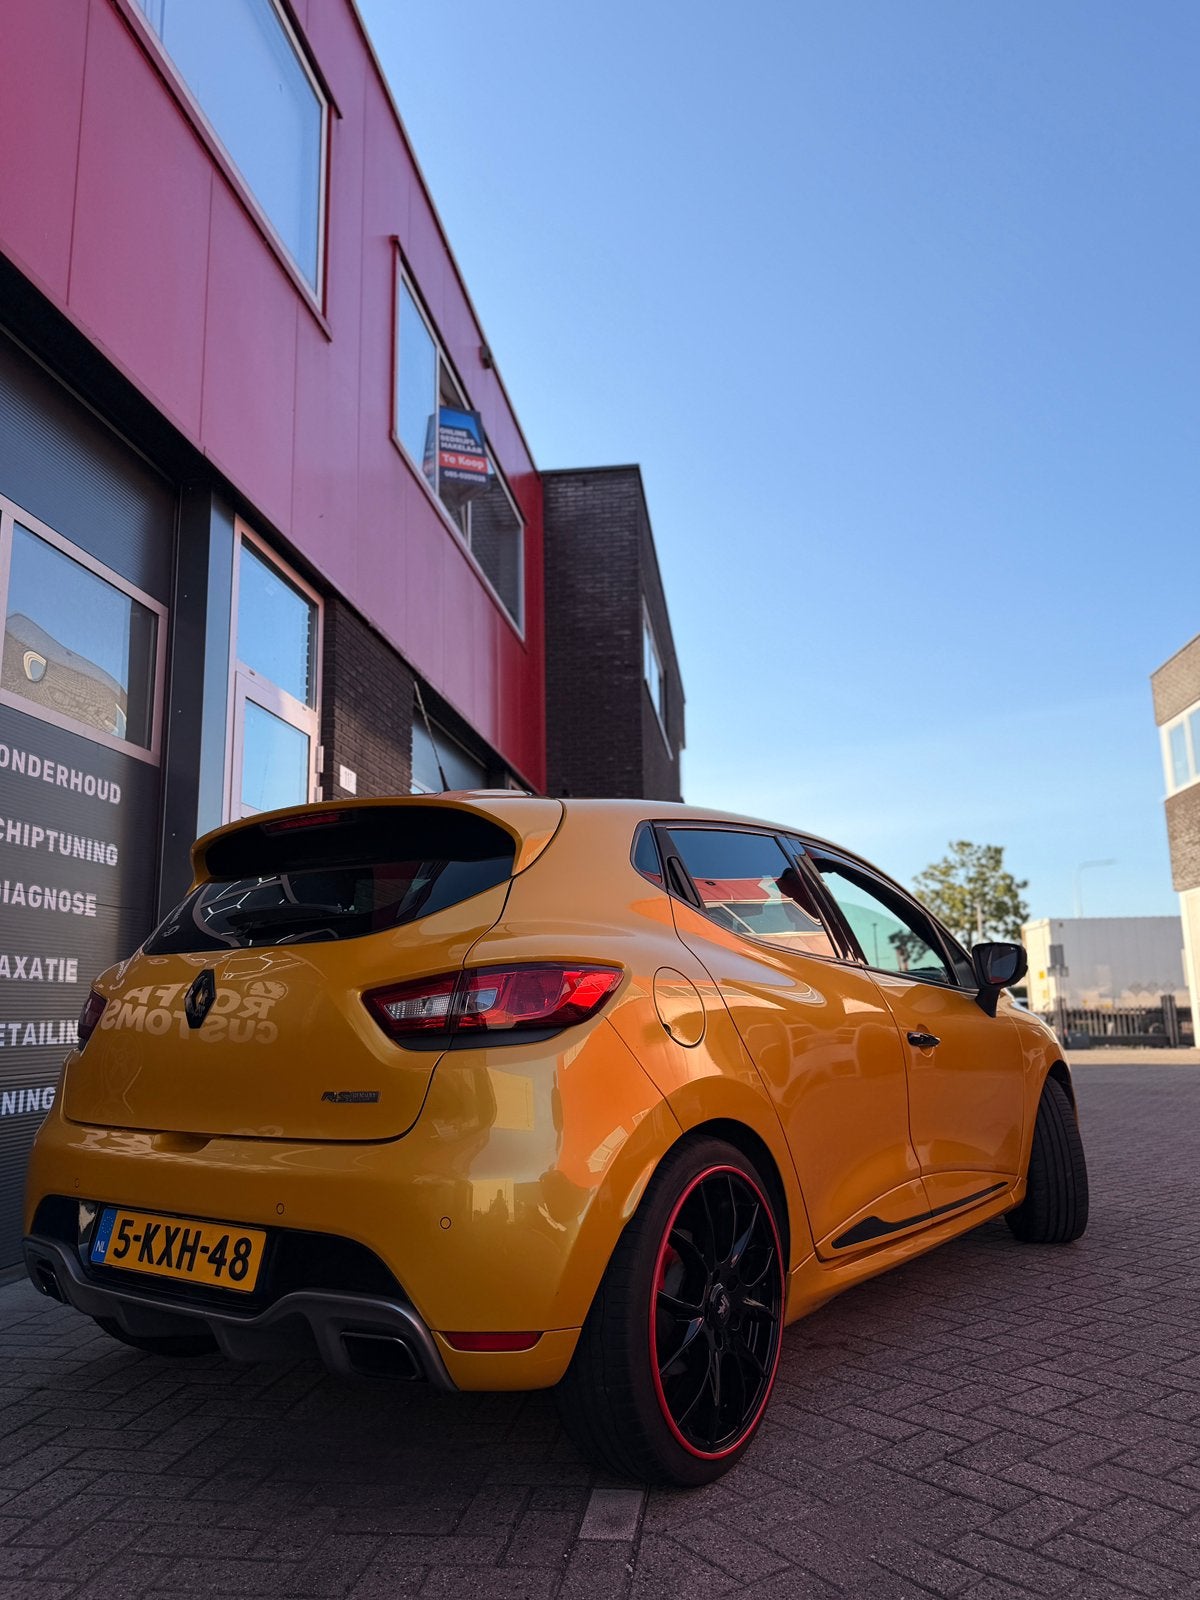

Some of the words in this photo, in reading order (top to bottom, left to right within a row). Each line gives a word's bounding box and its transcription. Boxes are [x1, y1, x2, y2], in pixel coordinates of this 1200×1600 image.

[458, 455, 485, 469] Koop
[0, 744, 121, 805] ONDERHOUD
[0, 880, 97, 917] IAGNOSE
[95, 1240, 105, 1253] NL
[113, 1218, 253, 1282] 5-KXH-48
